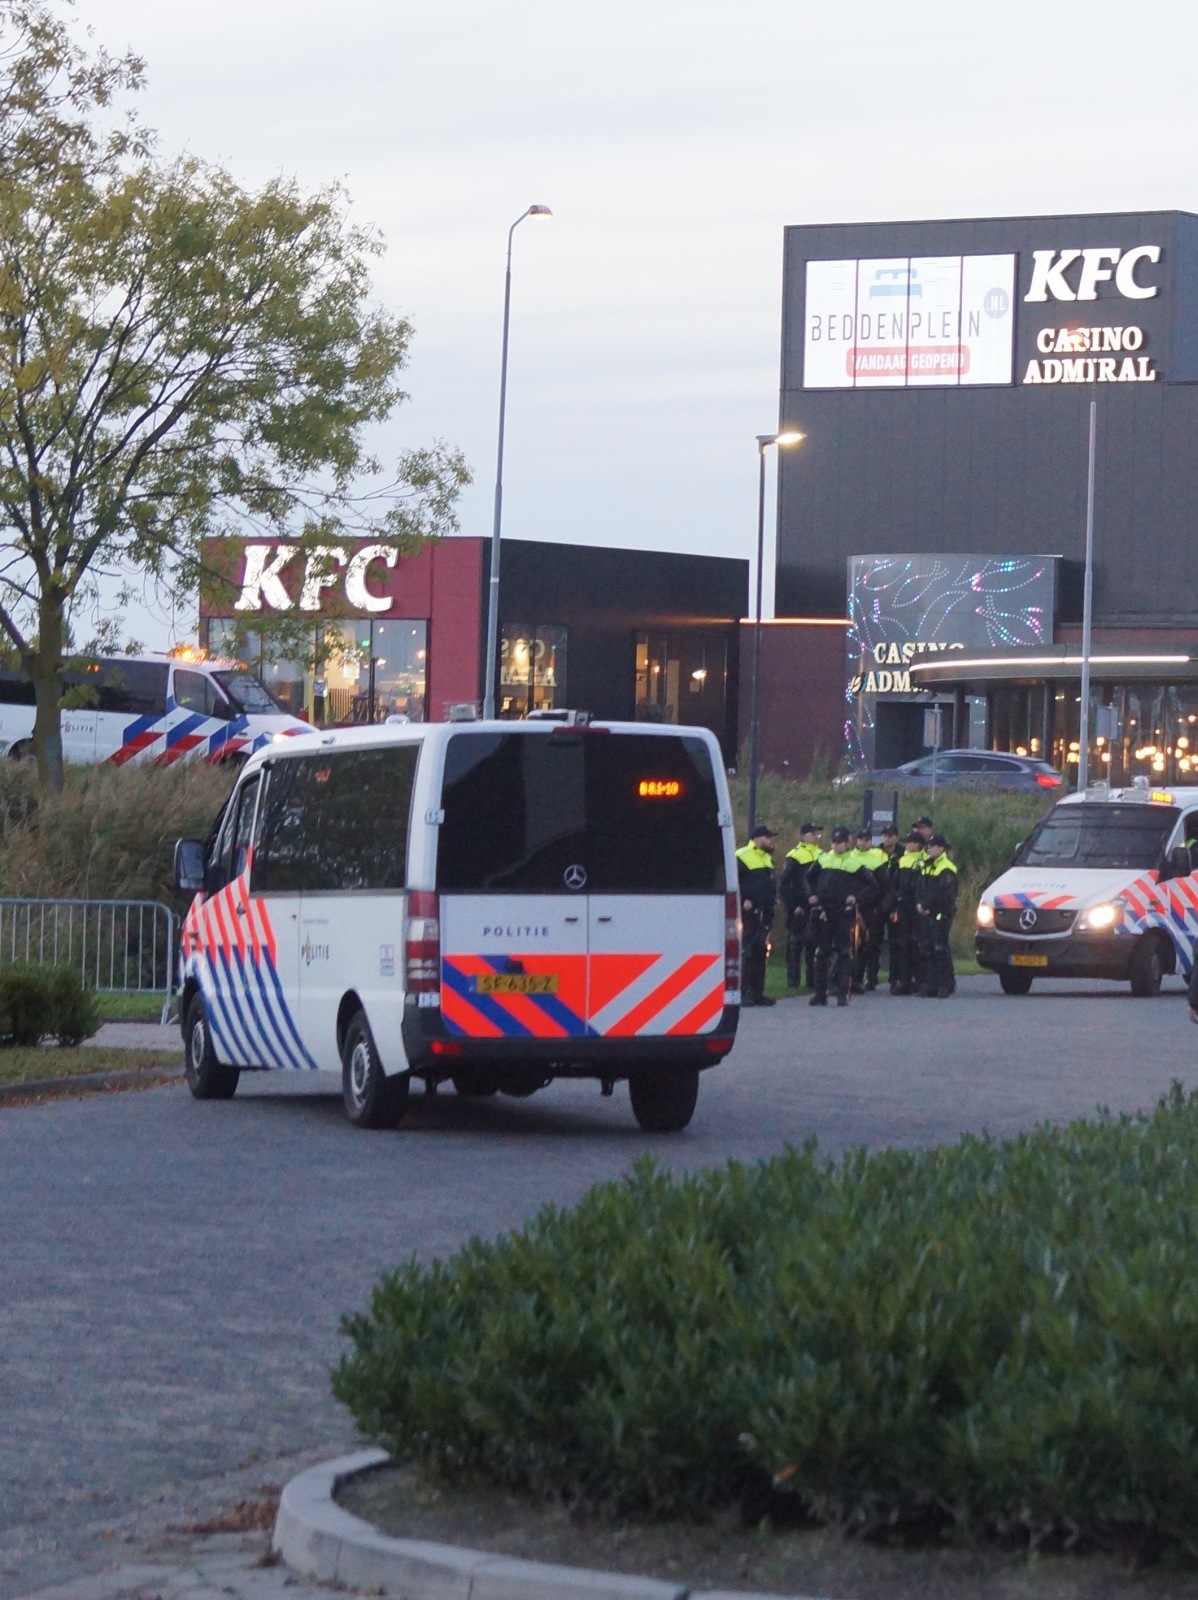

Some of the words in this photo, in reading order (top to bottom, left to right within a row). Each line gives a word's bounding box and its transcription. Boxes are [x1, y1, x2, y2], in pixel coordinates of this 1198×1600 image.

[1024, 245, 1160, 302] KFC
[811, 310, 980, 341] BEDDENPLEIN
[1037, 326, 1143, 352] CASINO
[852, 354, 906, 371] VANDAAG
[911, 353, 964, 370] GEOPEND
[1023, 357, 1156, 384] ADMIRAL
[234, 544, 399, 612] KFC
[482, 926, 550, 937] POLITIE
